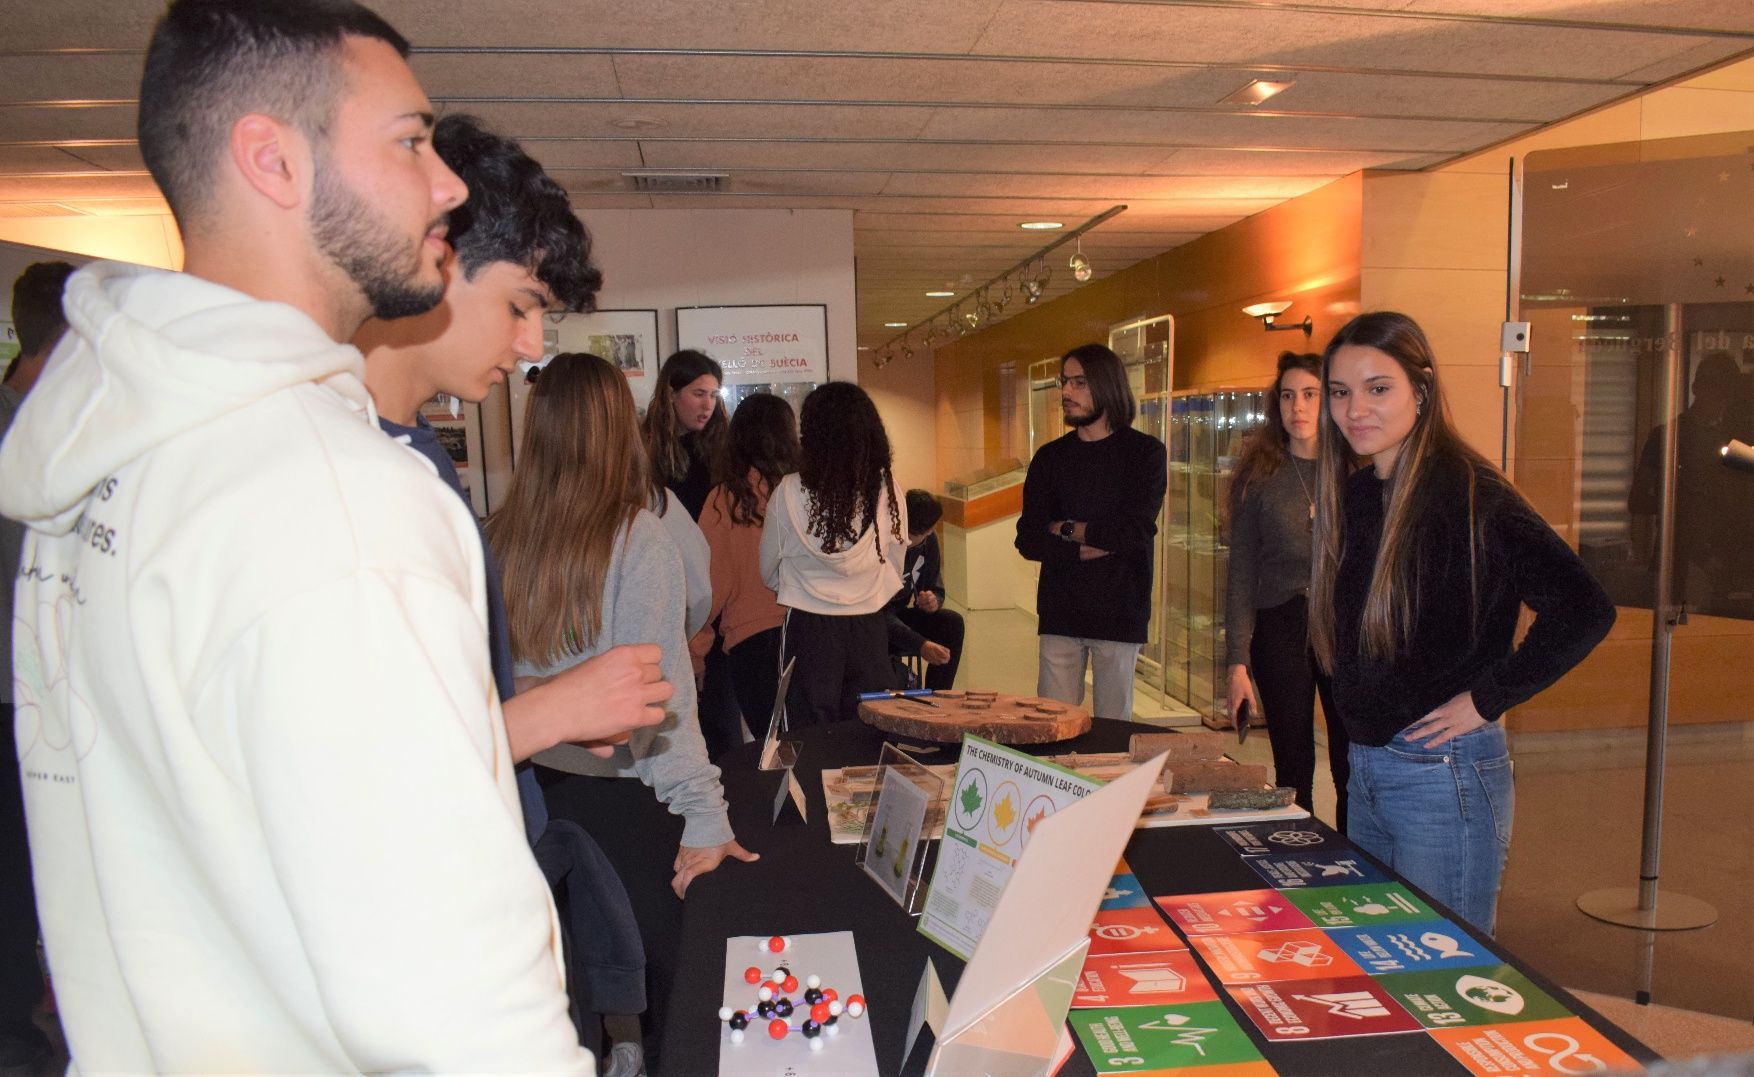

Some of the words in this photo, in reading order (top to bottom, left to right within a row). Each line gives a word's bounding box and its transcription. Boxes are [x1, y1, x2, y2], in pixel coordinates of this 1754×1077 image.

[742, 332, 800, 344] HISTÒRICA
[769, 356, 808, 369] SUÈCIA
[966, 745, 978, 758] THE
[978, 750, 1014, 772] CHEMISTRY
[1013, 762, 1024, 774] OF
[1024, 767, 1054, 787] AUTUMN
[1054, 776, 1072, 793] LEAF
[1321, 916, 1354, 924] 15
[1370, 960, 1406, 971] 14
[1229, 971, 1262, 980] 9
[1405, 994, 1435, 1011] CLIMATE
[1425, 994, 1452, 1010] ACTION
[1426, 1011, 1466, 1024] 13
[1274, 1025, 1310, 1034] 8
[1109, 1056, 1145, 1065] 3
